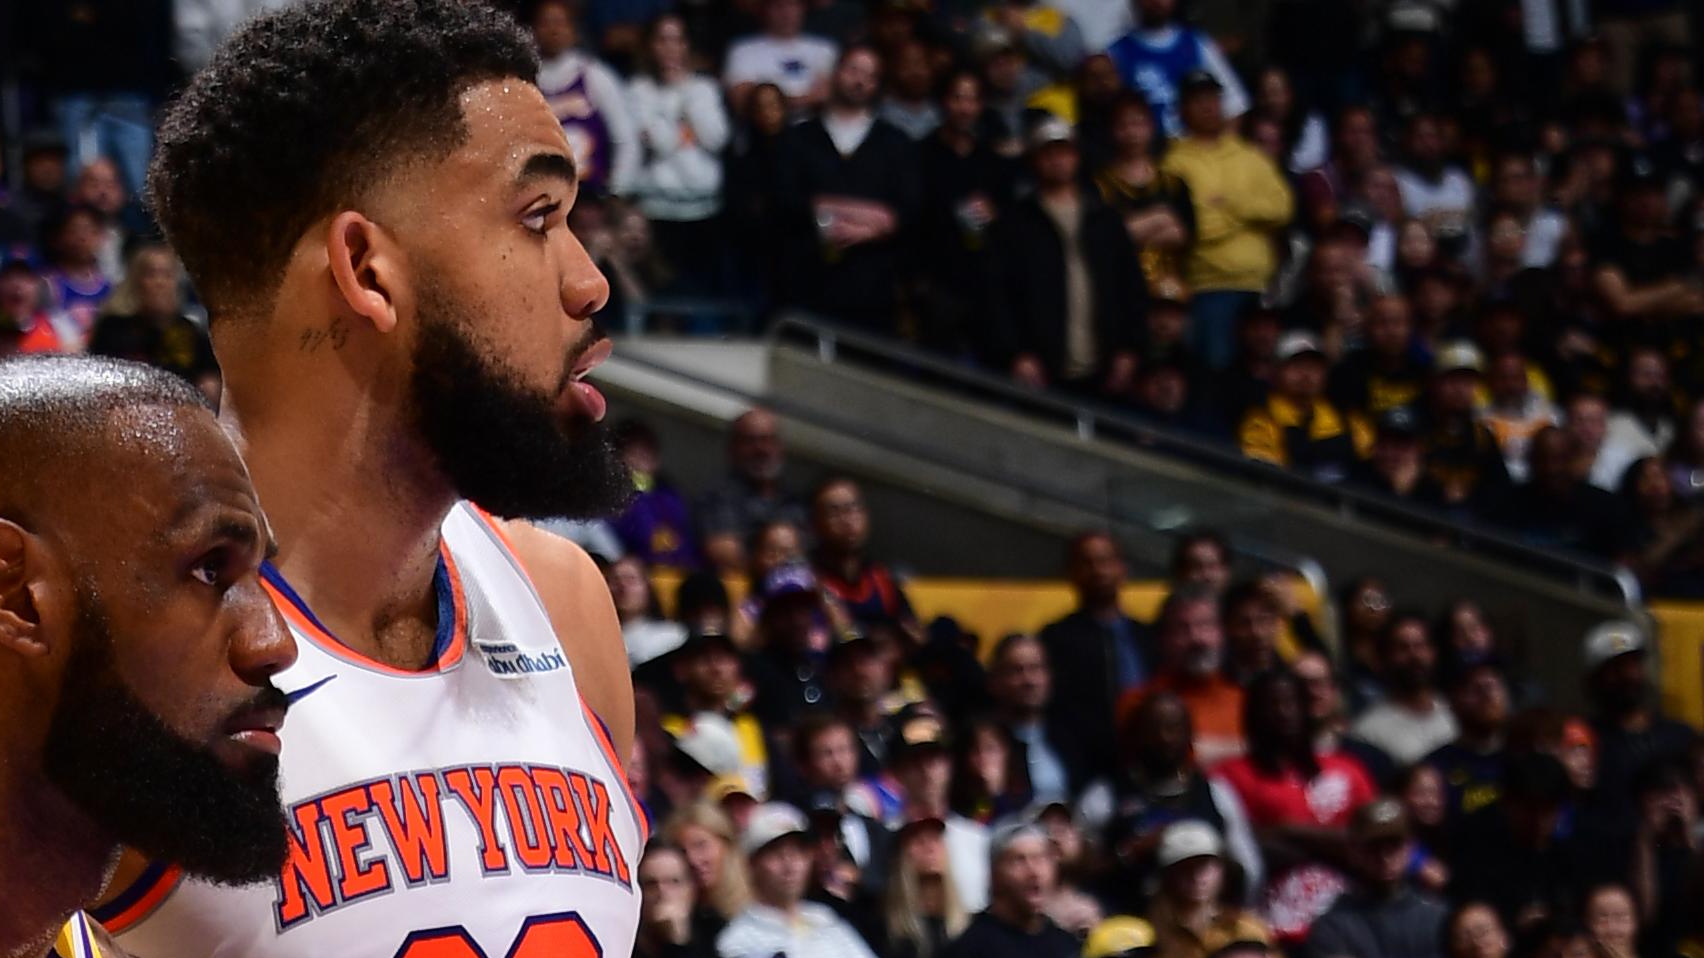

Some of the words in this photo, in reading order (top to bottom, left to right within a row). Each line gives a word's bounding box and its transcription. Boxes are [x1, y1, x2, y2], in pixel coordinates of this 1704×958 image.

[516, 648, 566, 673] dhabi
[273, 772, 450, 934] NEW
[437, 762, 634, 895] YORK
